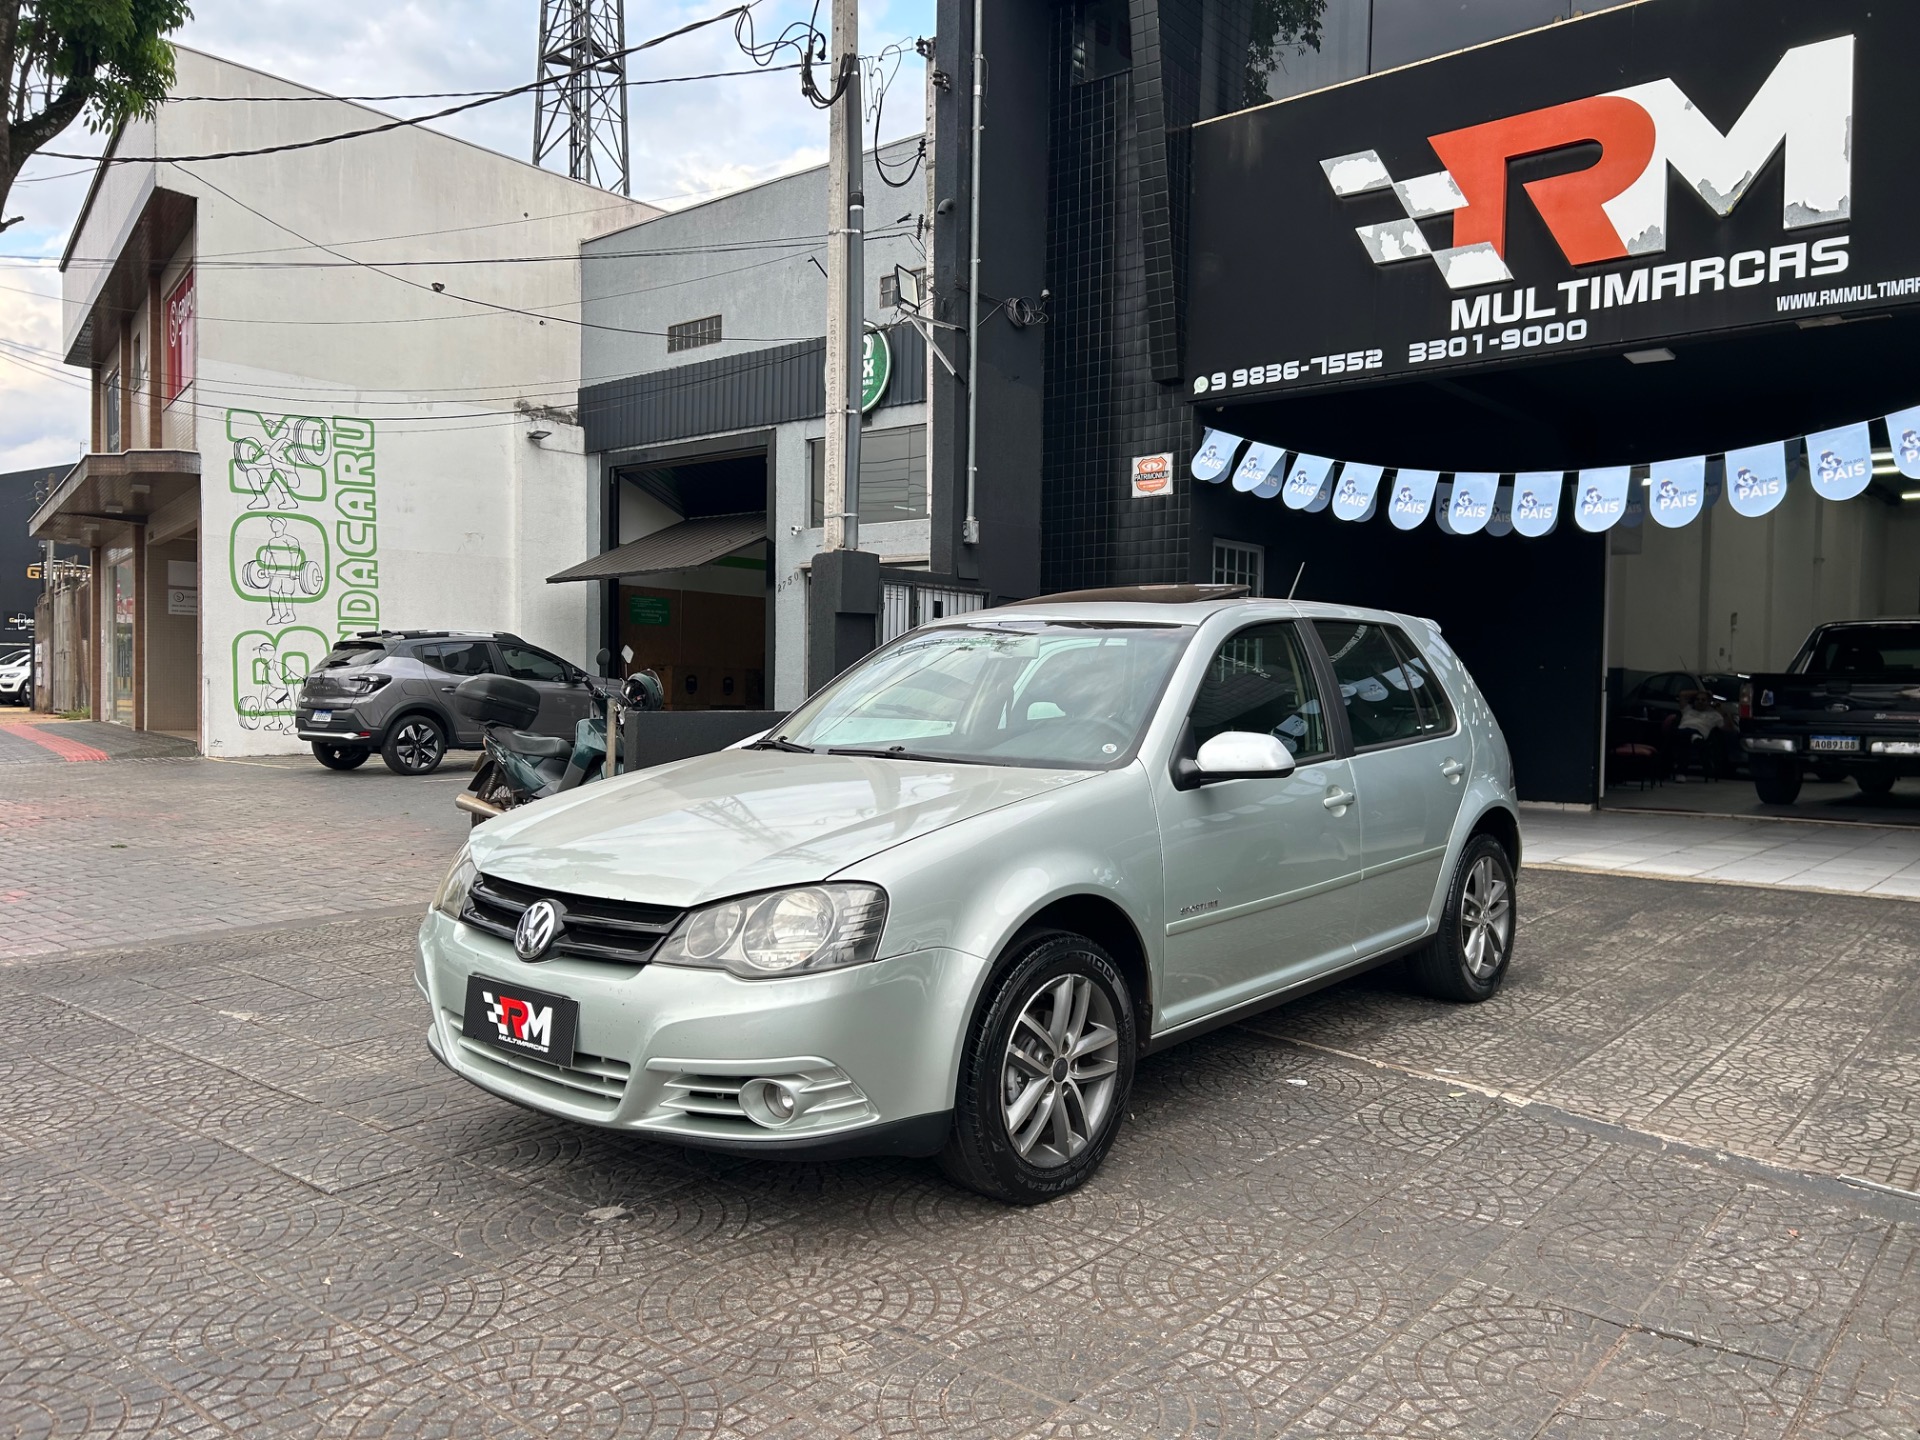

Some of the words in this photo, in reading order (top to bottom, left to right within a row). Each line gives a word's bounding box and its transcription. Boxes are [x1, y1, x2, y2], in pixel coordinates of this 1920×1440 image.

[1427, 34, 1854, 266] RM
[1451, 235, 1851, 331] MULTIMARCAS
[1210, 371, 1227, 392] 9
[1231, 348, 1383, 388] 9836-7552
[1408, 318, 1588, 363] 3301-9000
[1199, 456, 1224, 470] PAIS
[1240, 468, 1265, 480] PAIS
[1822, 463, 1866, 484] PAIS
[1290, 483, 1317, 497] PAIS
[1738, 480, 1780, 500] PAIS
[1340, 493, 1369, 507] PAIS
[1395, 502, 1425, 514] PAIS
[1584, 501, 1619, 515] PAIS
[1660, 494, 1697, 510] PAIS
[1455, 506, 1486, 518] PAIS
[1520, 507, 1553, 519] PAIS
[333, 415, 380, 641] DACARU
[777, 571, 799, 593] 2750
[499, 995, 553, 1047] RM
[498, 1033, 549, 1053] MULTIMARCAS
